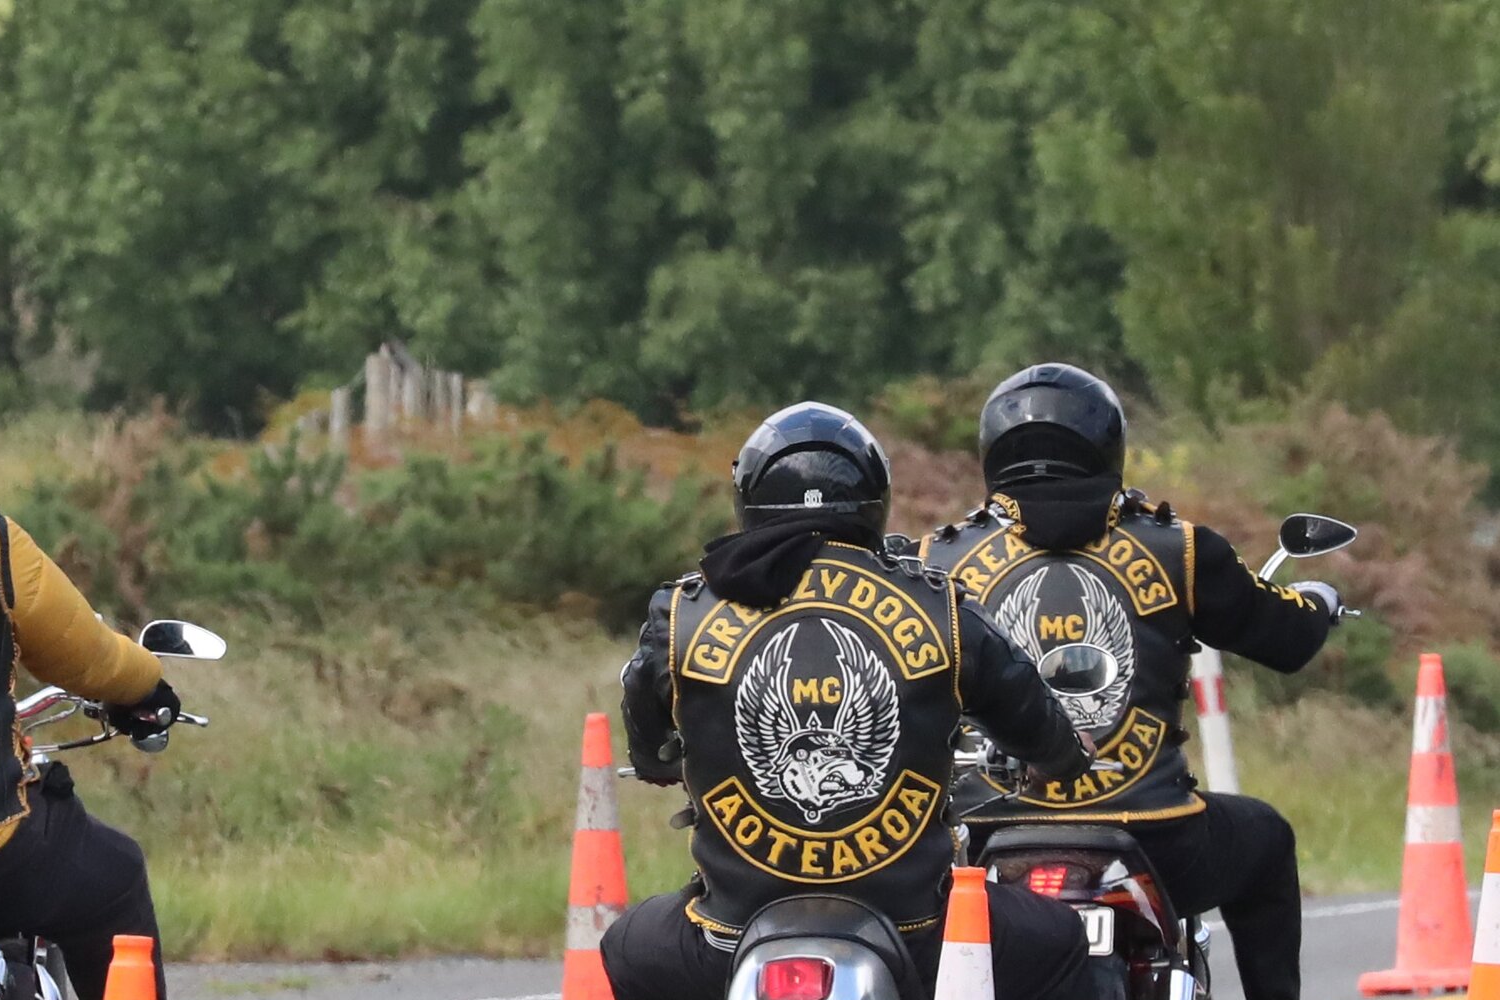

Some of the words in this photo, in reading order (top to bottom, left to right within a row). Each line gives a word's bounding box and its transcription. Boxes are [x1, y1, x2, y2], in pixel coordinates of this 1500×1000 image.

[694, 568, 848, 670] GREZY
[848, 579, 940, 669] DOGS
[1039, 614, 1085, 641] MC
[793, 676, 842, 704] MC
[712, 786, 930, 876] AOTEAROA
